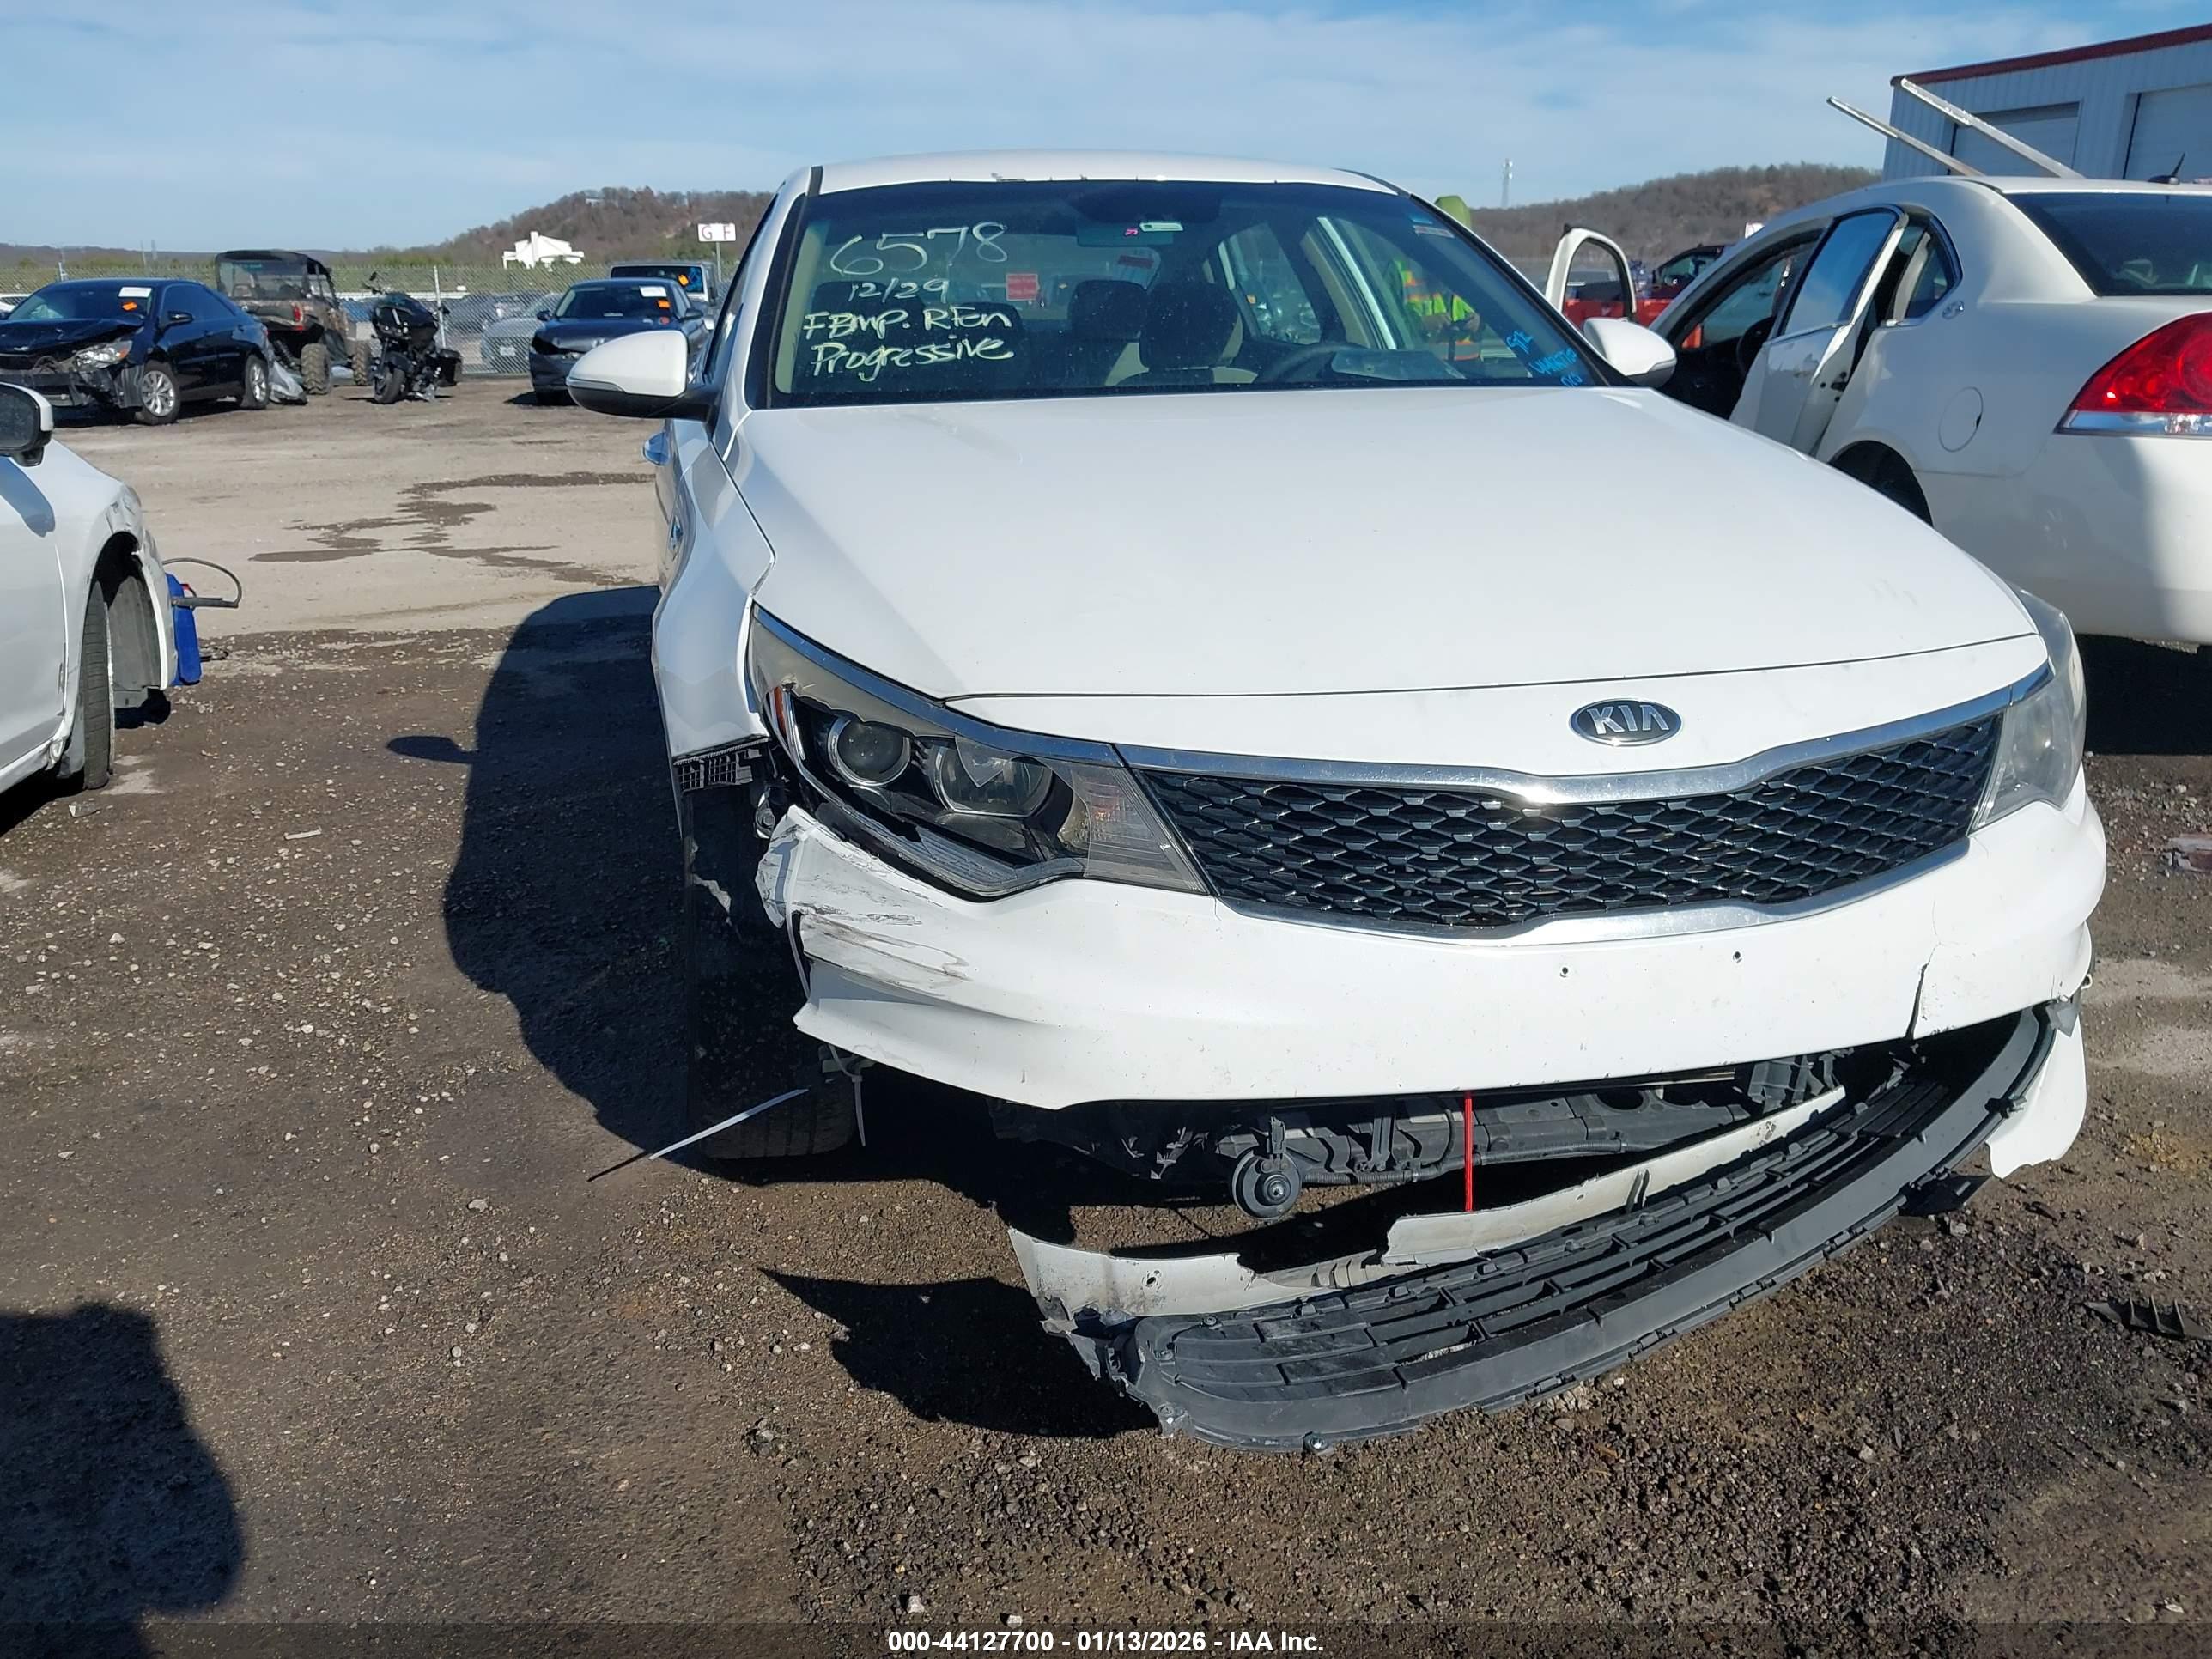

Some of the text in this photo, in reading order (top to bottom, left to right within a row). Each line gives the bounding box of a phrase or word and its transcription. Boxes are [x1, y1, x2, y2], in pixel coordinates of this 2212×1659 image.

[701, 223, 732, 241] G F
[830, 222, 1009, 276] 6578
[848, 277, 950, 304] 12/29
[810, 333, 1015, 383] Progressive
[1586, 704, 1671, 736] KIA
